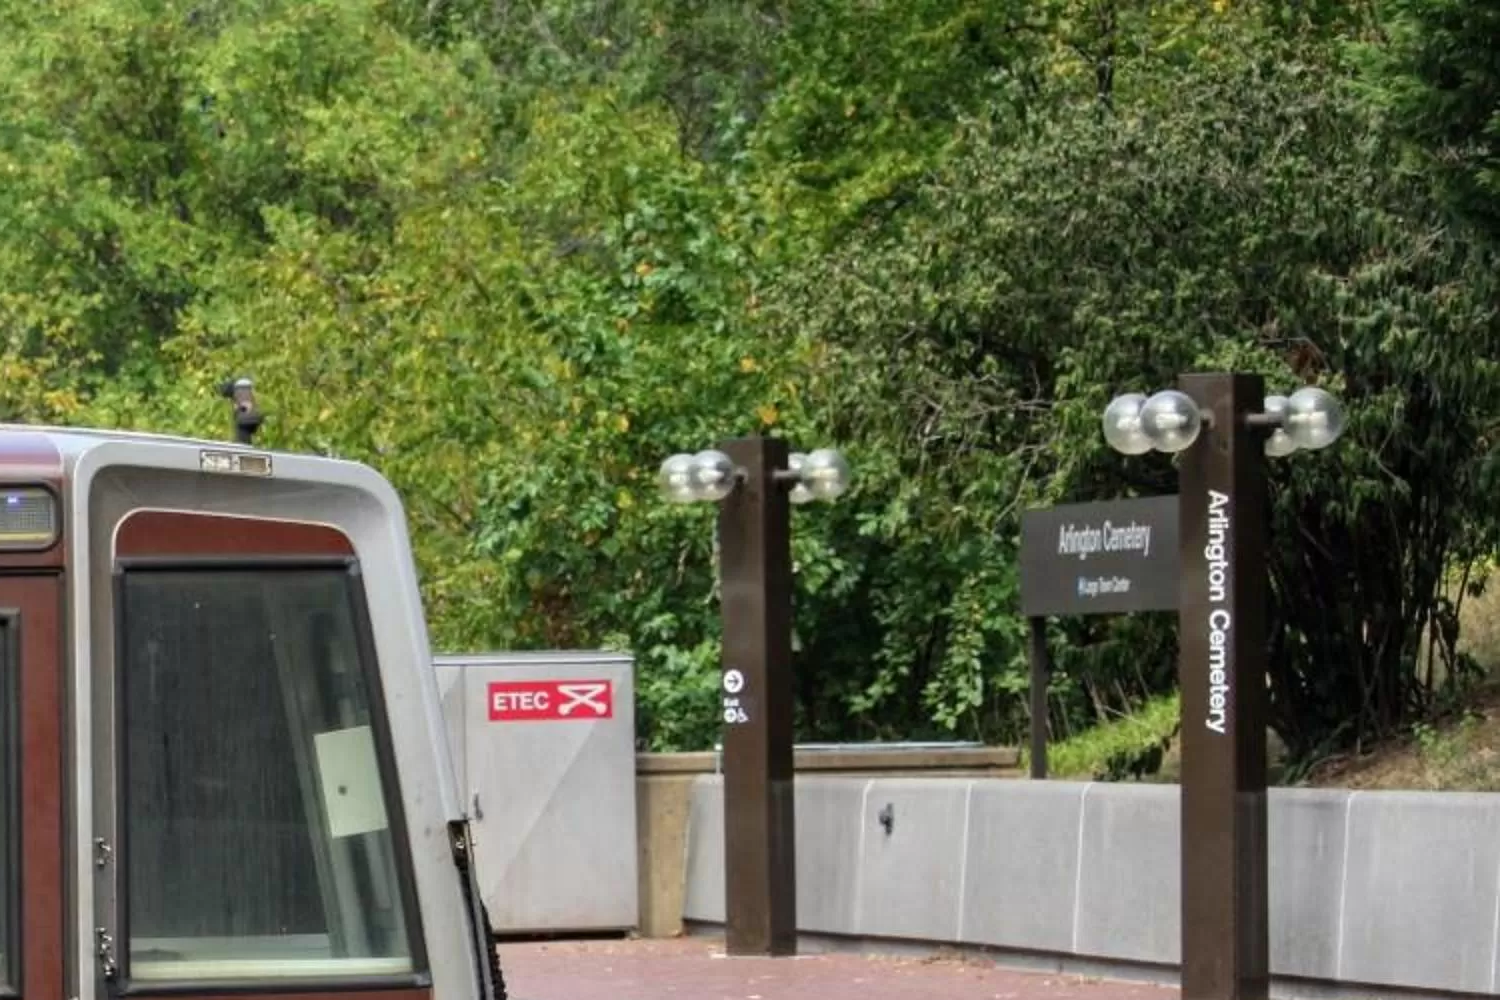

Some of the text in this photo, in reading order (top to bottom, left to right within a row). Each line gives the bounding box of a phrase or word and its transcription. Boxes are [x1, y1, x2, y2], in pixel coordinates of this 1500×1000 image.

[1058, 520, 1152, 560] Arlington Cemetery
[1204, 490, 1231, 733] Arlington Cemetery
[493, 690, 550, 711] ETEC
